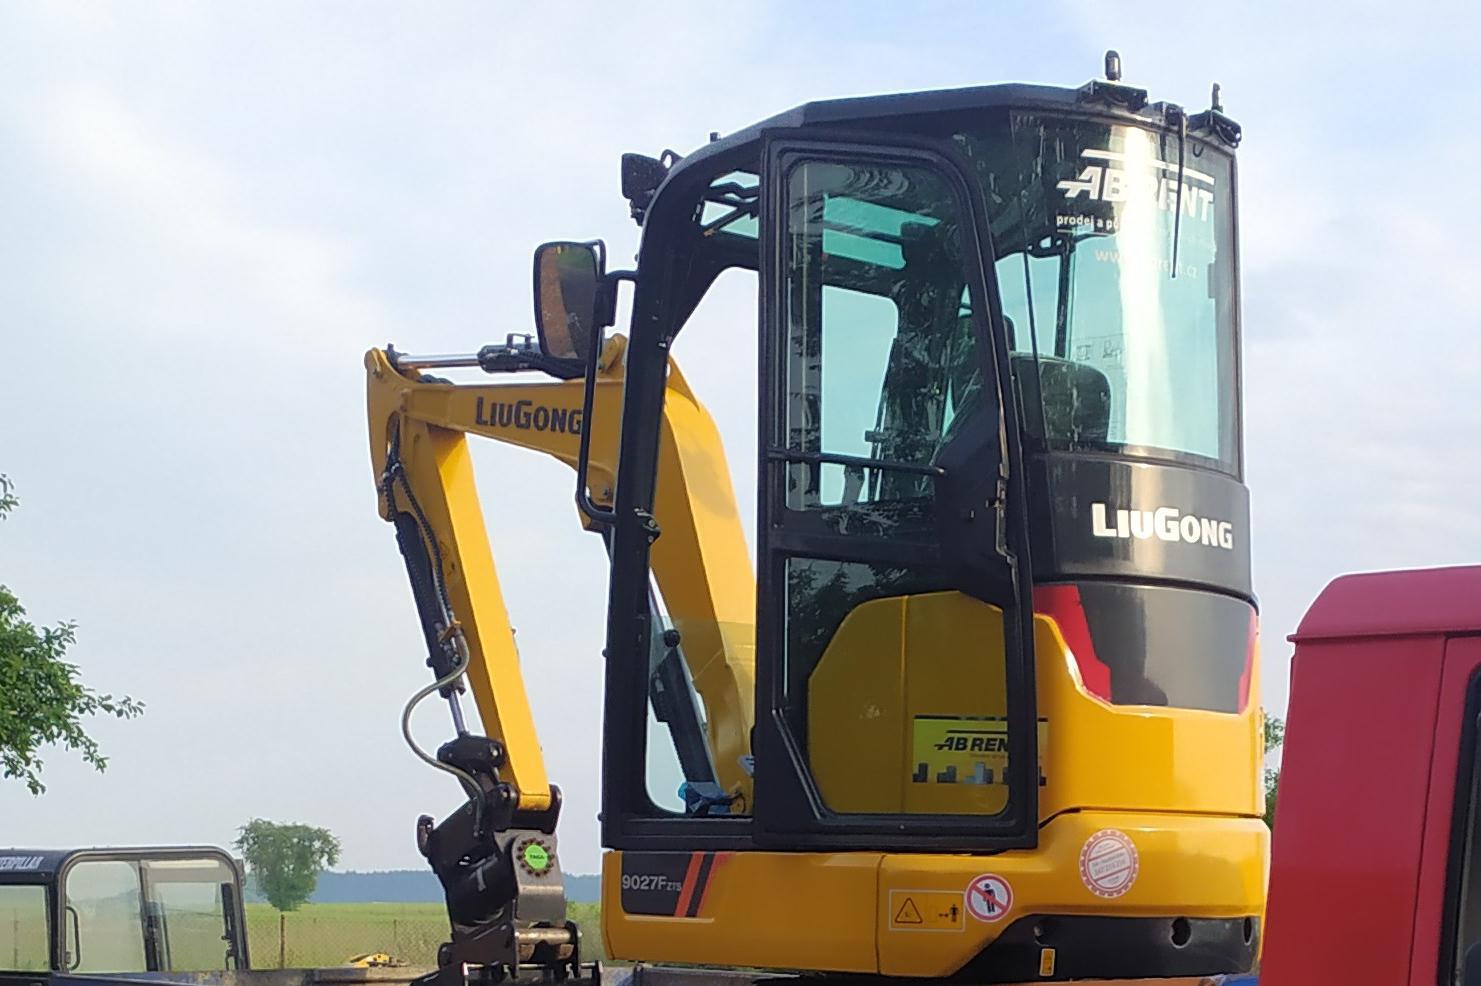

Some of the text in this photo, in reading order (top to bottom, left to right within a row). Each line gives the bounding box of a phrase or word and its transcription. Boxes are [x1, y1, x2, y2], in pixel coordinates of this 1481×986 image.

[1056, 213, 1094, 229] prodej
[934, 736, 1008, 752] AB REN
